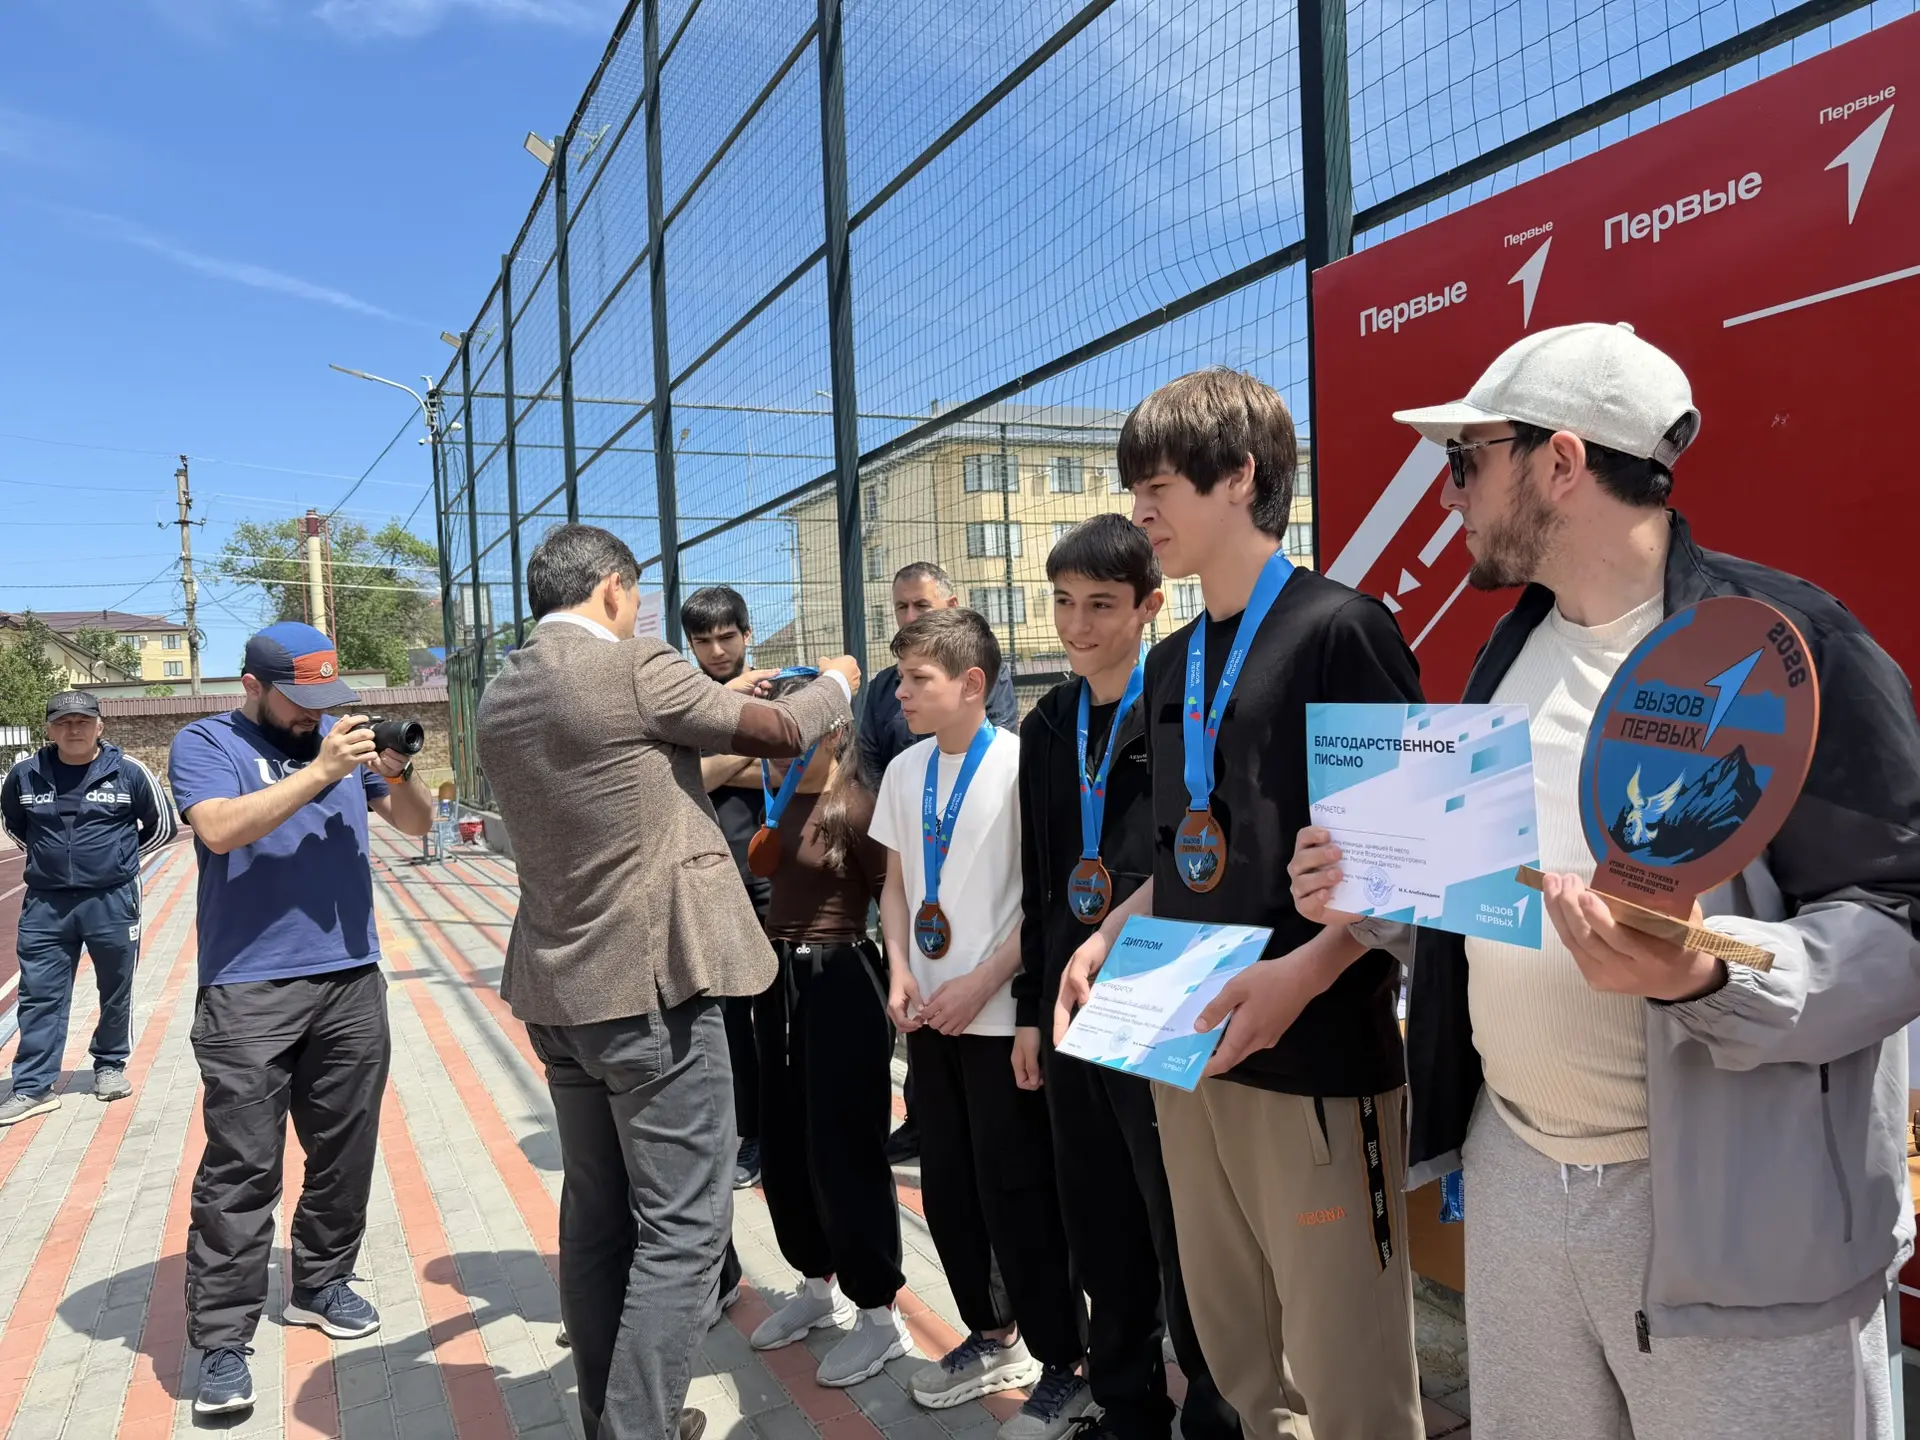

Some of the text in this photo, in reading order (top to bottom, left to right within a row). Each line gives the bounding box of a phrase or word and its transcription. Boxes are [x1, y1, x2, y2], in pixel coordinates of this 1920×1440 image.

[1819, 86, 1896, 125] Первые
[1604, 171, 1763, 250] Первые
[1504, 220, 1554, 248] Первые
[1360, 279, 1468, 337] Первые
[1766, 621, 1807, 689] 2026
[1632, 689, 1706, 718] ВЫЗОВ
[1314, 735, 1456, 754] БЛАГОДАРСТВЕННОЕ
[1620, 717, 1701, 749] ПЕРВЫХ
[1314, 753, 1364, 768] ПИСЬМО
[85, 789, 116, 804] das
[1314, 804, 1346, 815] ВРУЧАЕТСЯ
[1475, 914, 1514, 927] ПЕРВЫХ
[1480, 903, 1514, 916] ВЫЗОВ
[1121, 936, 1163, 951] ДИПЛОМ
[1367, 1139, 1379, 1169] ZEGNA
[1375, 1189, 1385, 1219] ZEGNA
